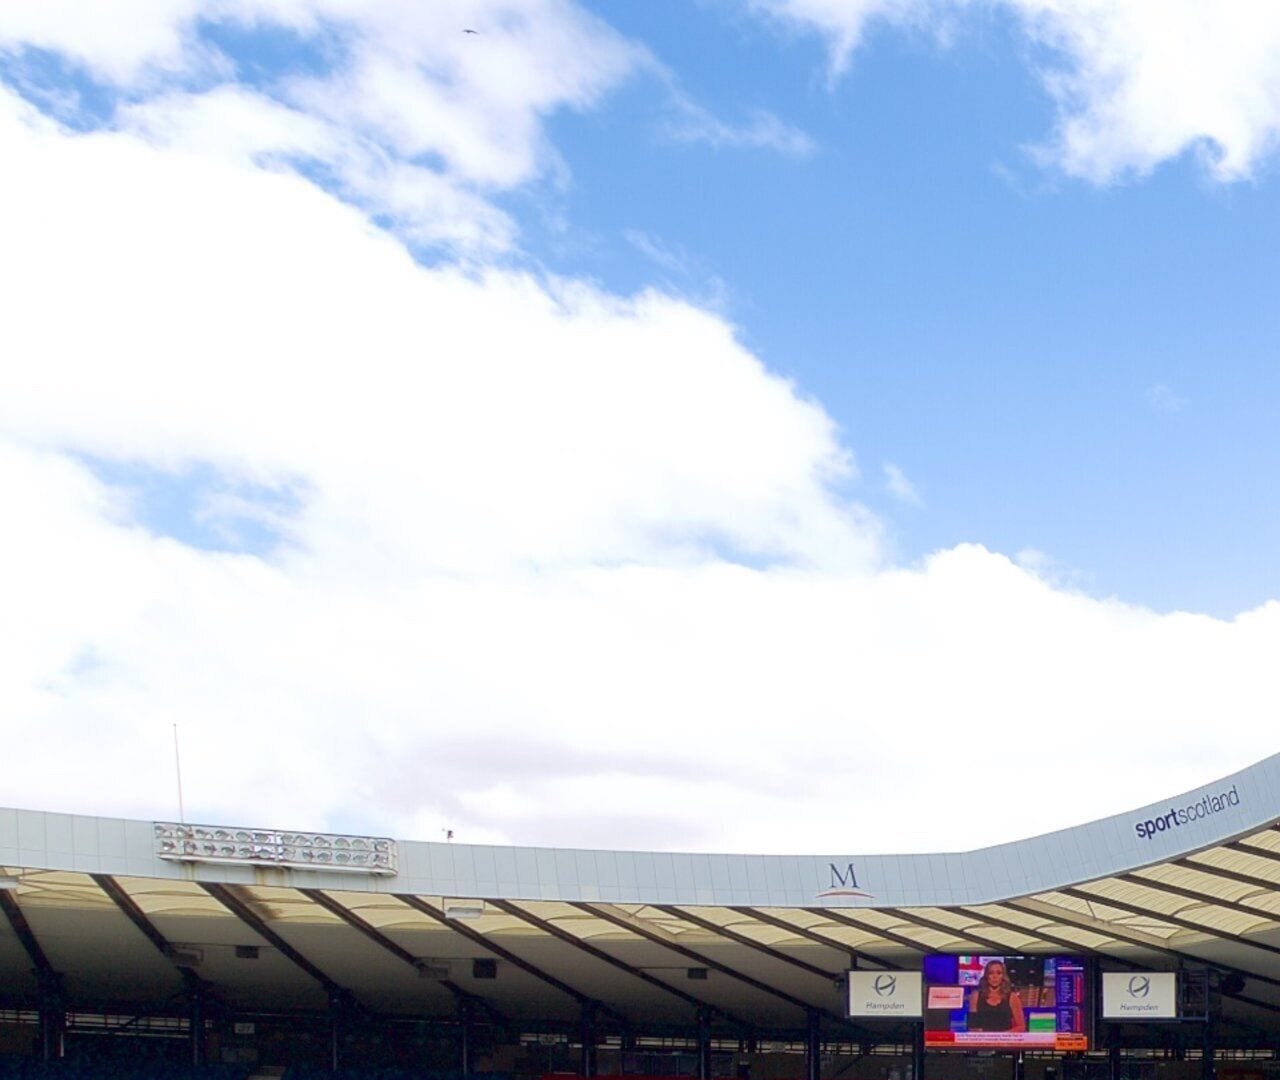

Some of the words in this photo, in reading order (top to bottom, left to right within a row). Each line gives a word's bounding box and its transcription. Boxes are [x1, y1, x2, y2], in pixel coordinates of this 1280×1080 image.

[1135, 786, 1240, 840] sportscotland
[829, 863, 861, 889] M
[866, 1002, 905, 1011] Hampden
[1120, 1003, 1159, 1012] Hampden
